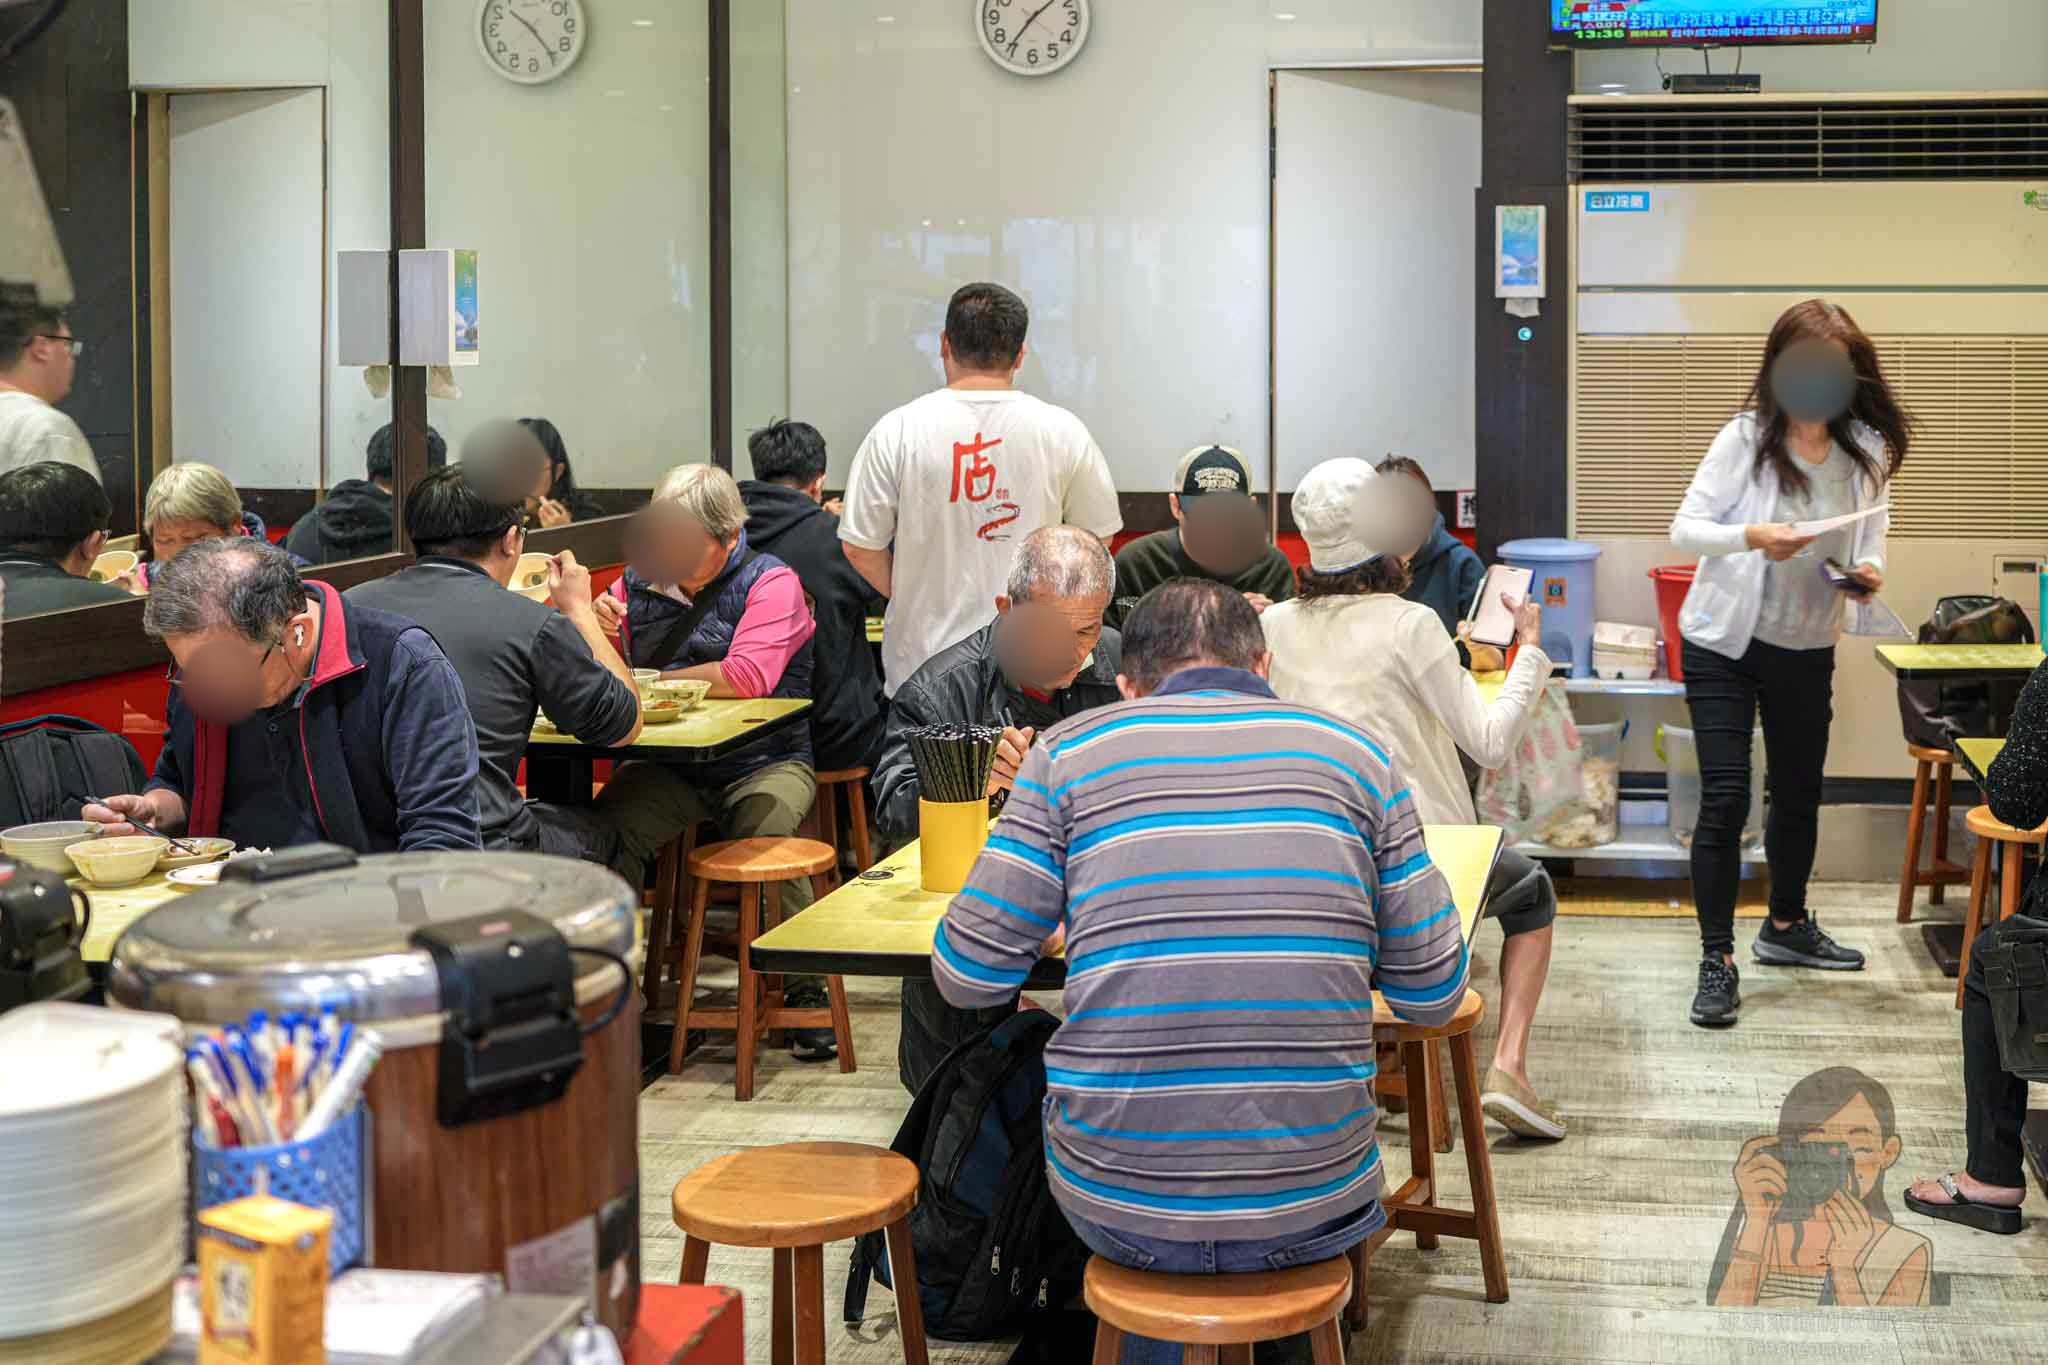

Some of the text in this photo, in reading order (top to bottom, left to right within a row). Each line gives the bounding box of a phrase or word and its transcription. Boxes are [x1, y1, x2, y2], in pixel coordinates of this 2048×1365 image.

[988, 9, 1001, 25] 9
[1067, 10, 1079, 26] 3
[994, 28, 1006, 44] 8
[1060, 29, 1072, 44] 4
[1574, 29, 1625, 39] 13:36
[1026, 48, 1039, 64] 6
[1047, 43, 1059, 59] 5
